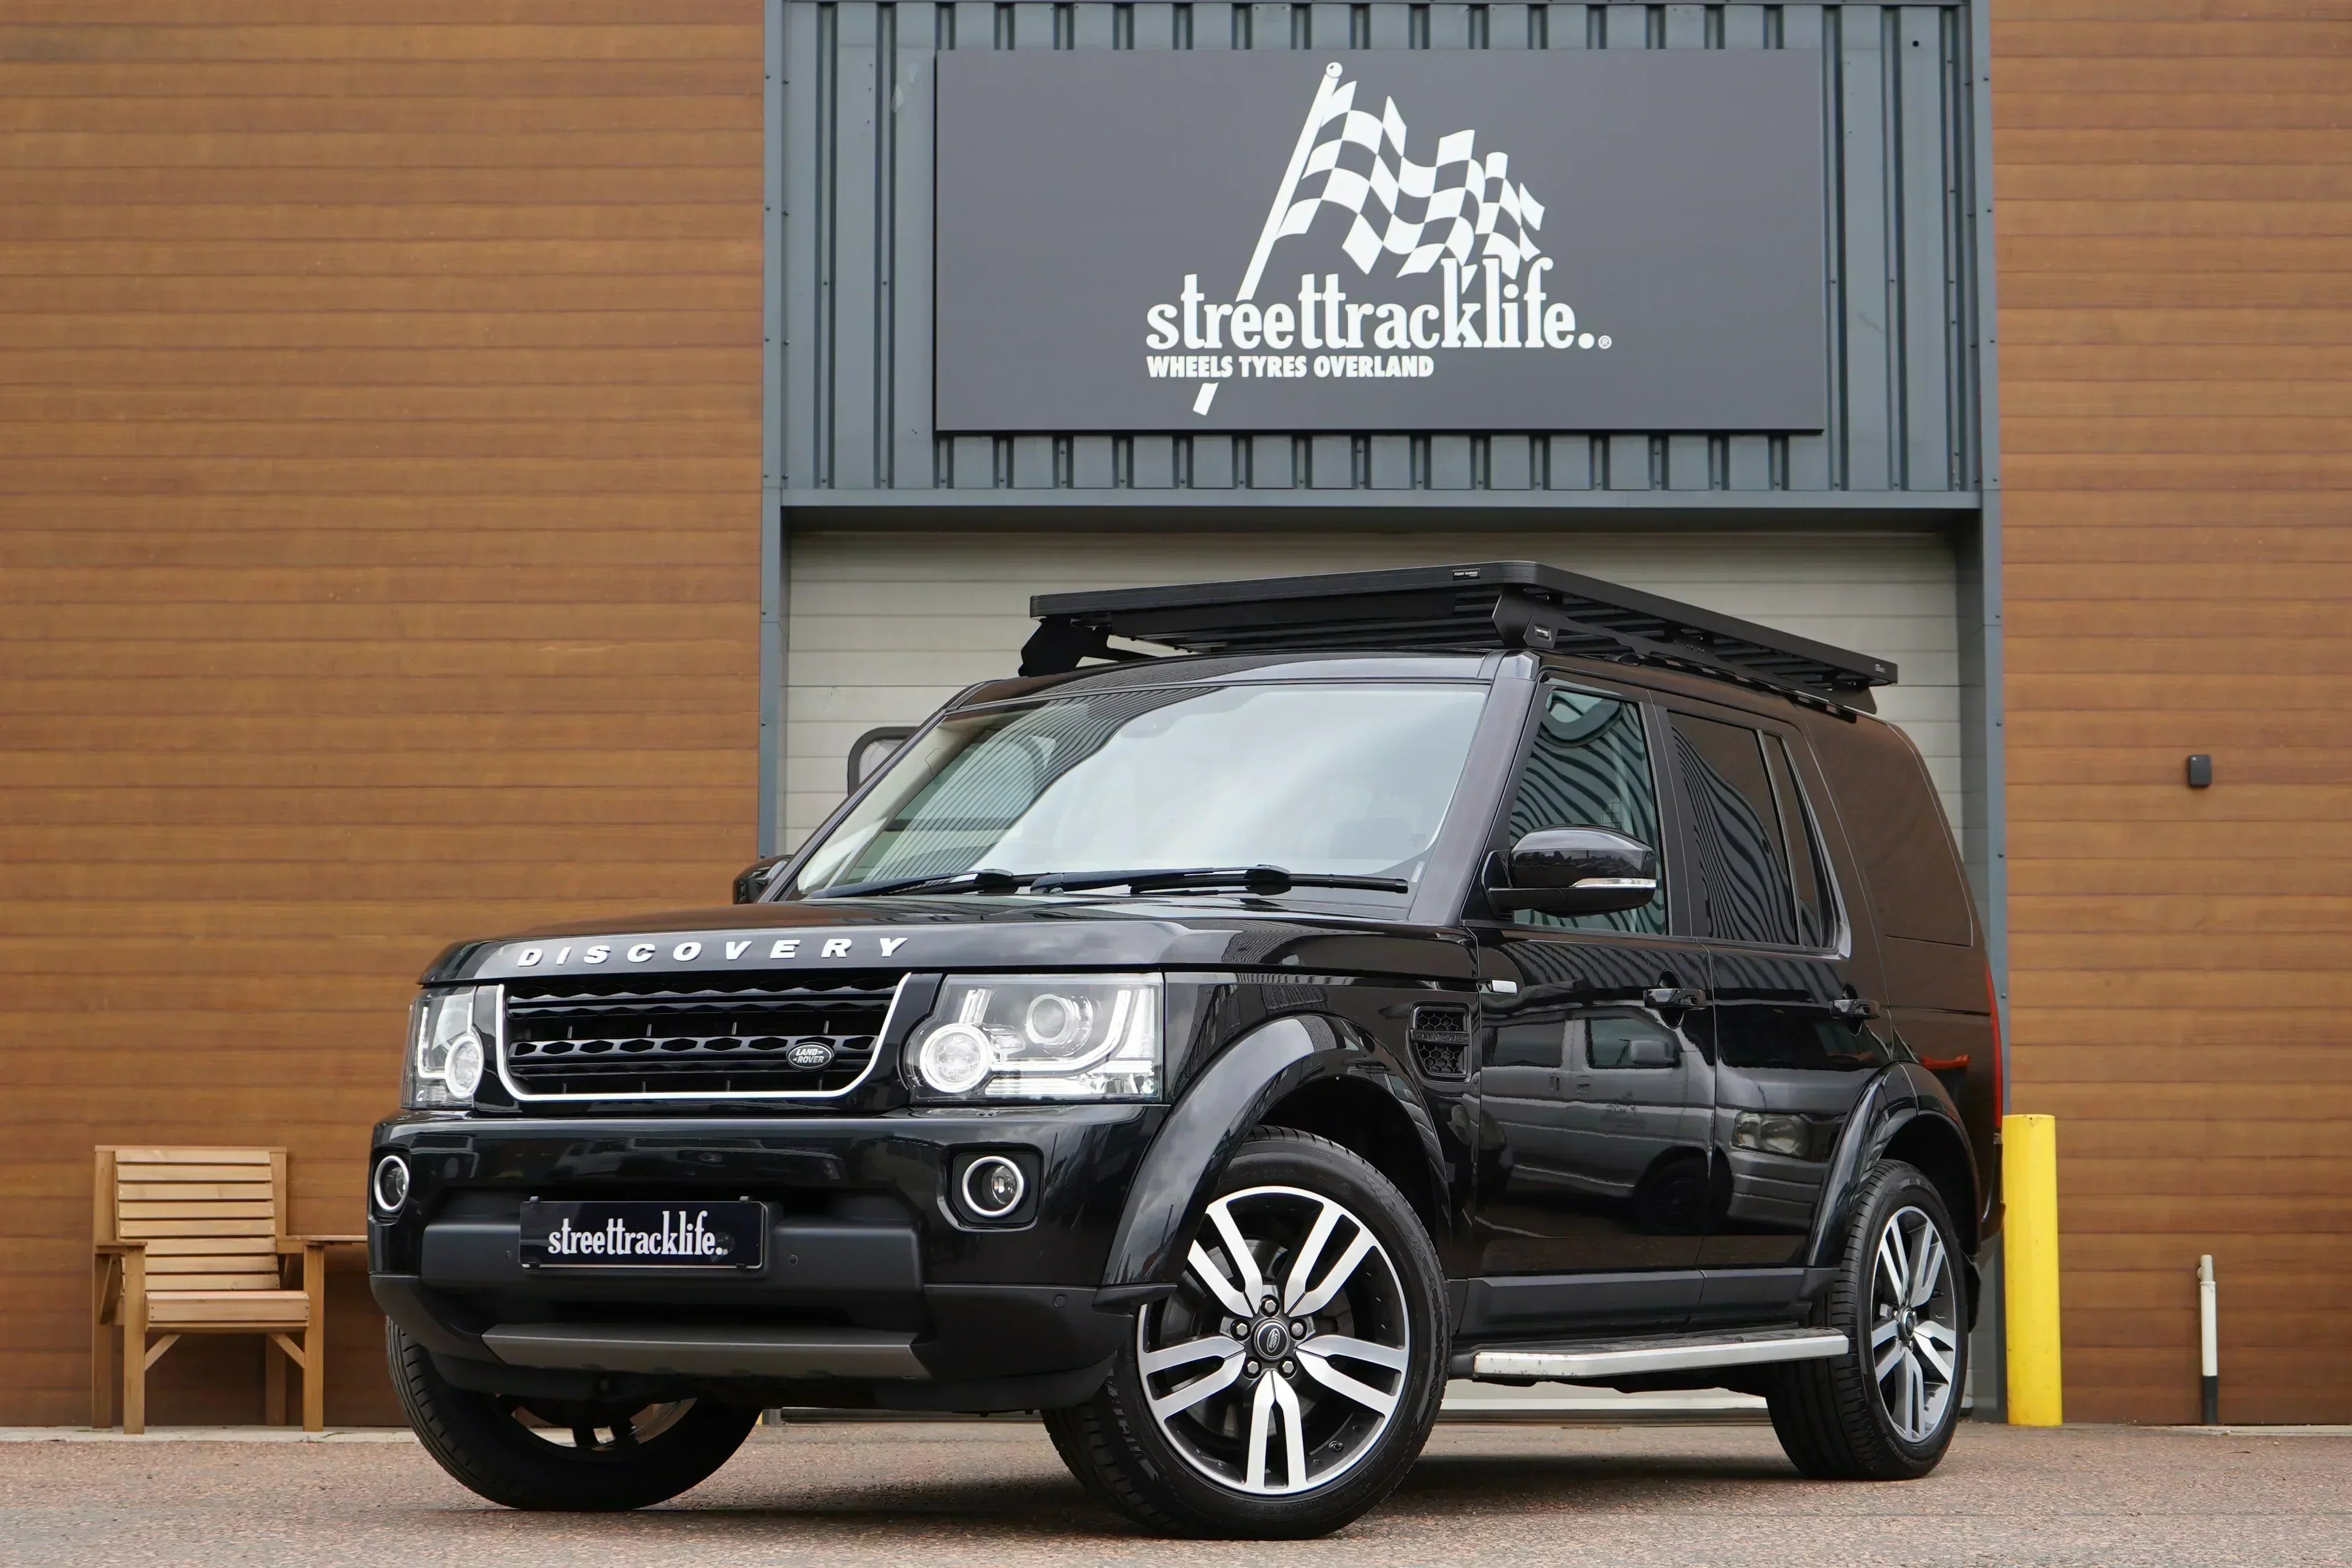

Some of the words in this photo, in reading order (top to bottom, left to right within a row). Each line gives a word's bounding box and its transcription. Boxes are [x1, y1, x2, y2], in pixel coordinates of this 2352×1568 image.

[1146, 355, 1234, 378] WHEELS
[1238, 355, 1307, 378] TYRES
[1313, 355, 1434, 378] OVERLAND
[517, 937, 908, 967] DISCOVERY
